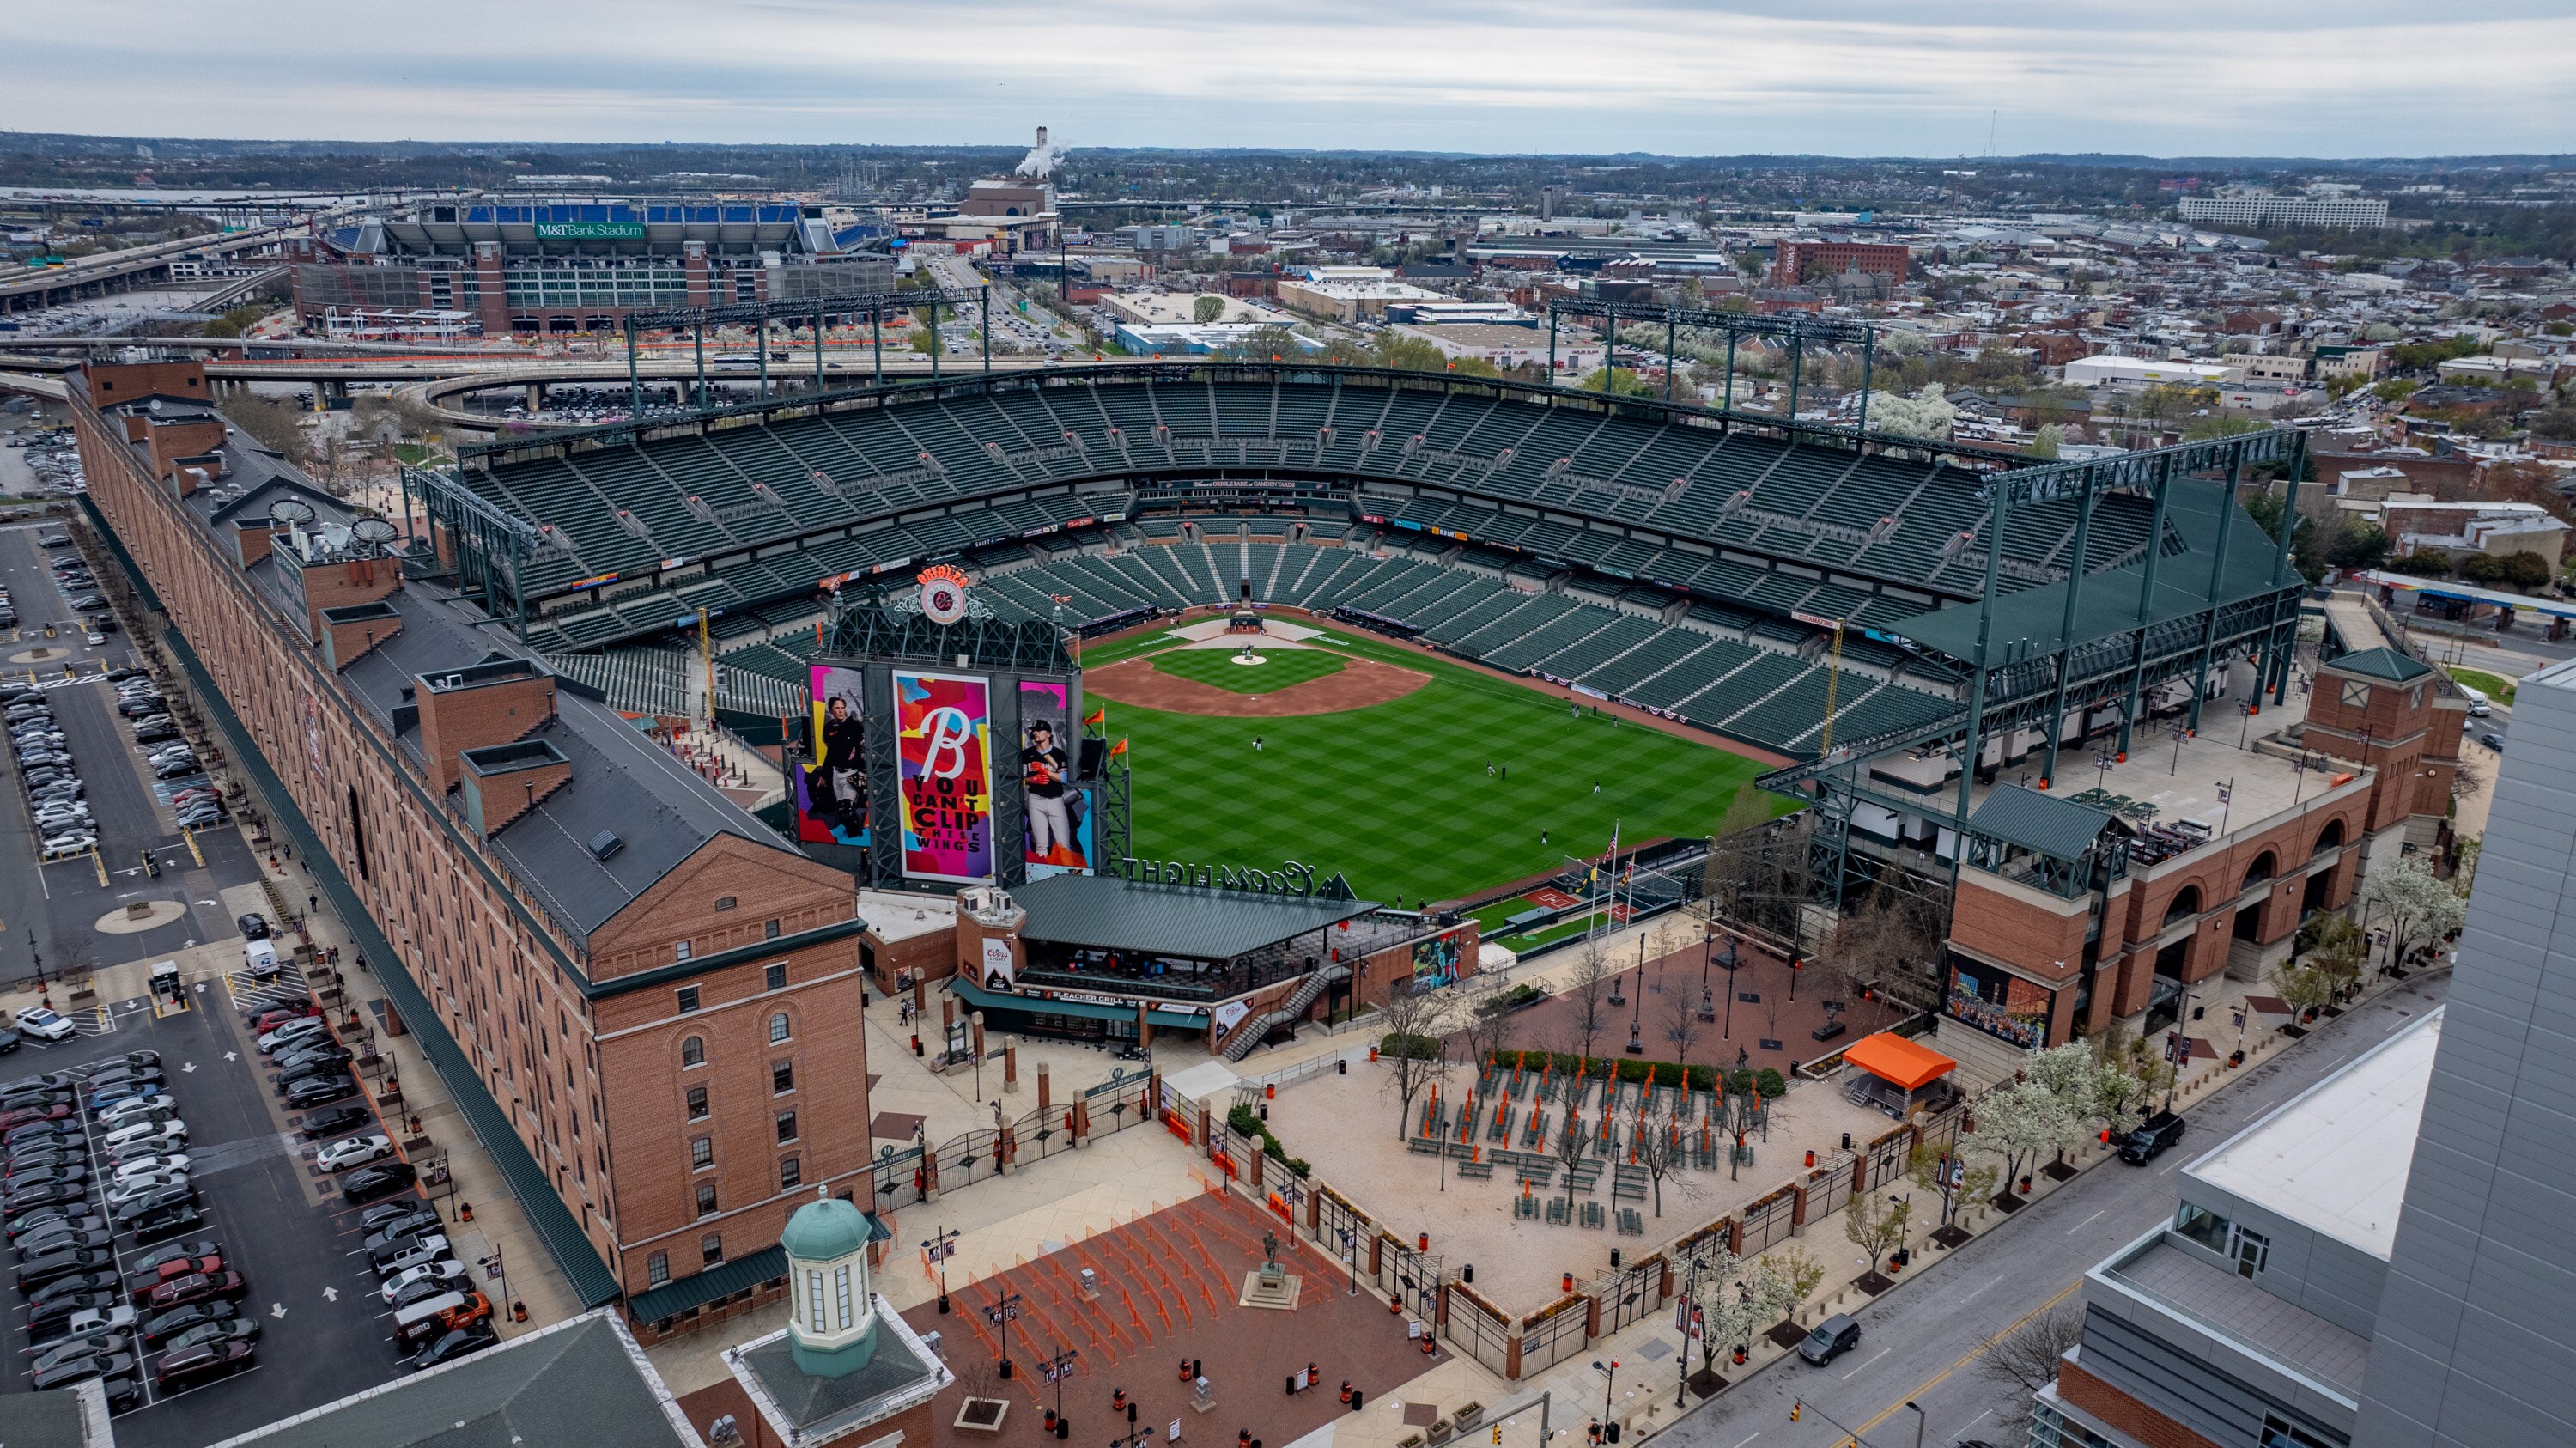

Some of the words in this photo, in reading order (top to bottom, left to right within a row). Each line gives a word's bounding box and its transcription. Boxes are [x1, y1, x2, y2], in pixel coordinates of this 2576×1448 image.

[538, 224, 568, 236] M&T
[568, 224, 596, 236] Bank
[597, 224, 641, 236] Stadium
[917, 565, 968, 588] ORIOLES
[1807, 616, 1833, 628] AMAZING
[920, 706, 971, 782] B
[913, 774, 978, 797] YOU
[913, 793, 978, 812] CAN'T
[914, 807, 979, 830] CLIP
[915, 827, 980, 841] THESE
[916, 837, 980, 853] WINGS
[987, 948, 1008, 958] Coors
[1053, 991, 1097, 1001] BLEACHER
[1098, 995, 1124, 1005] GRILL
[1098, 1081, 1118, 1092] EUTAW
[1118, 1074, 1138, 1086] STREET
[888, 1152, 911, 1164] STREET
[407, 1322, 431, 1337] BIRD
